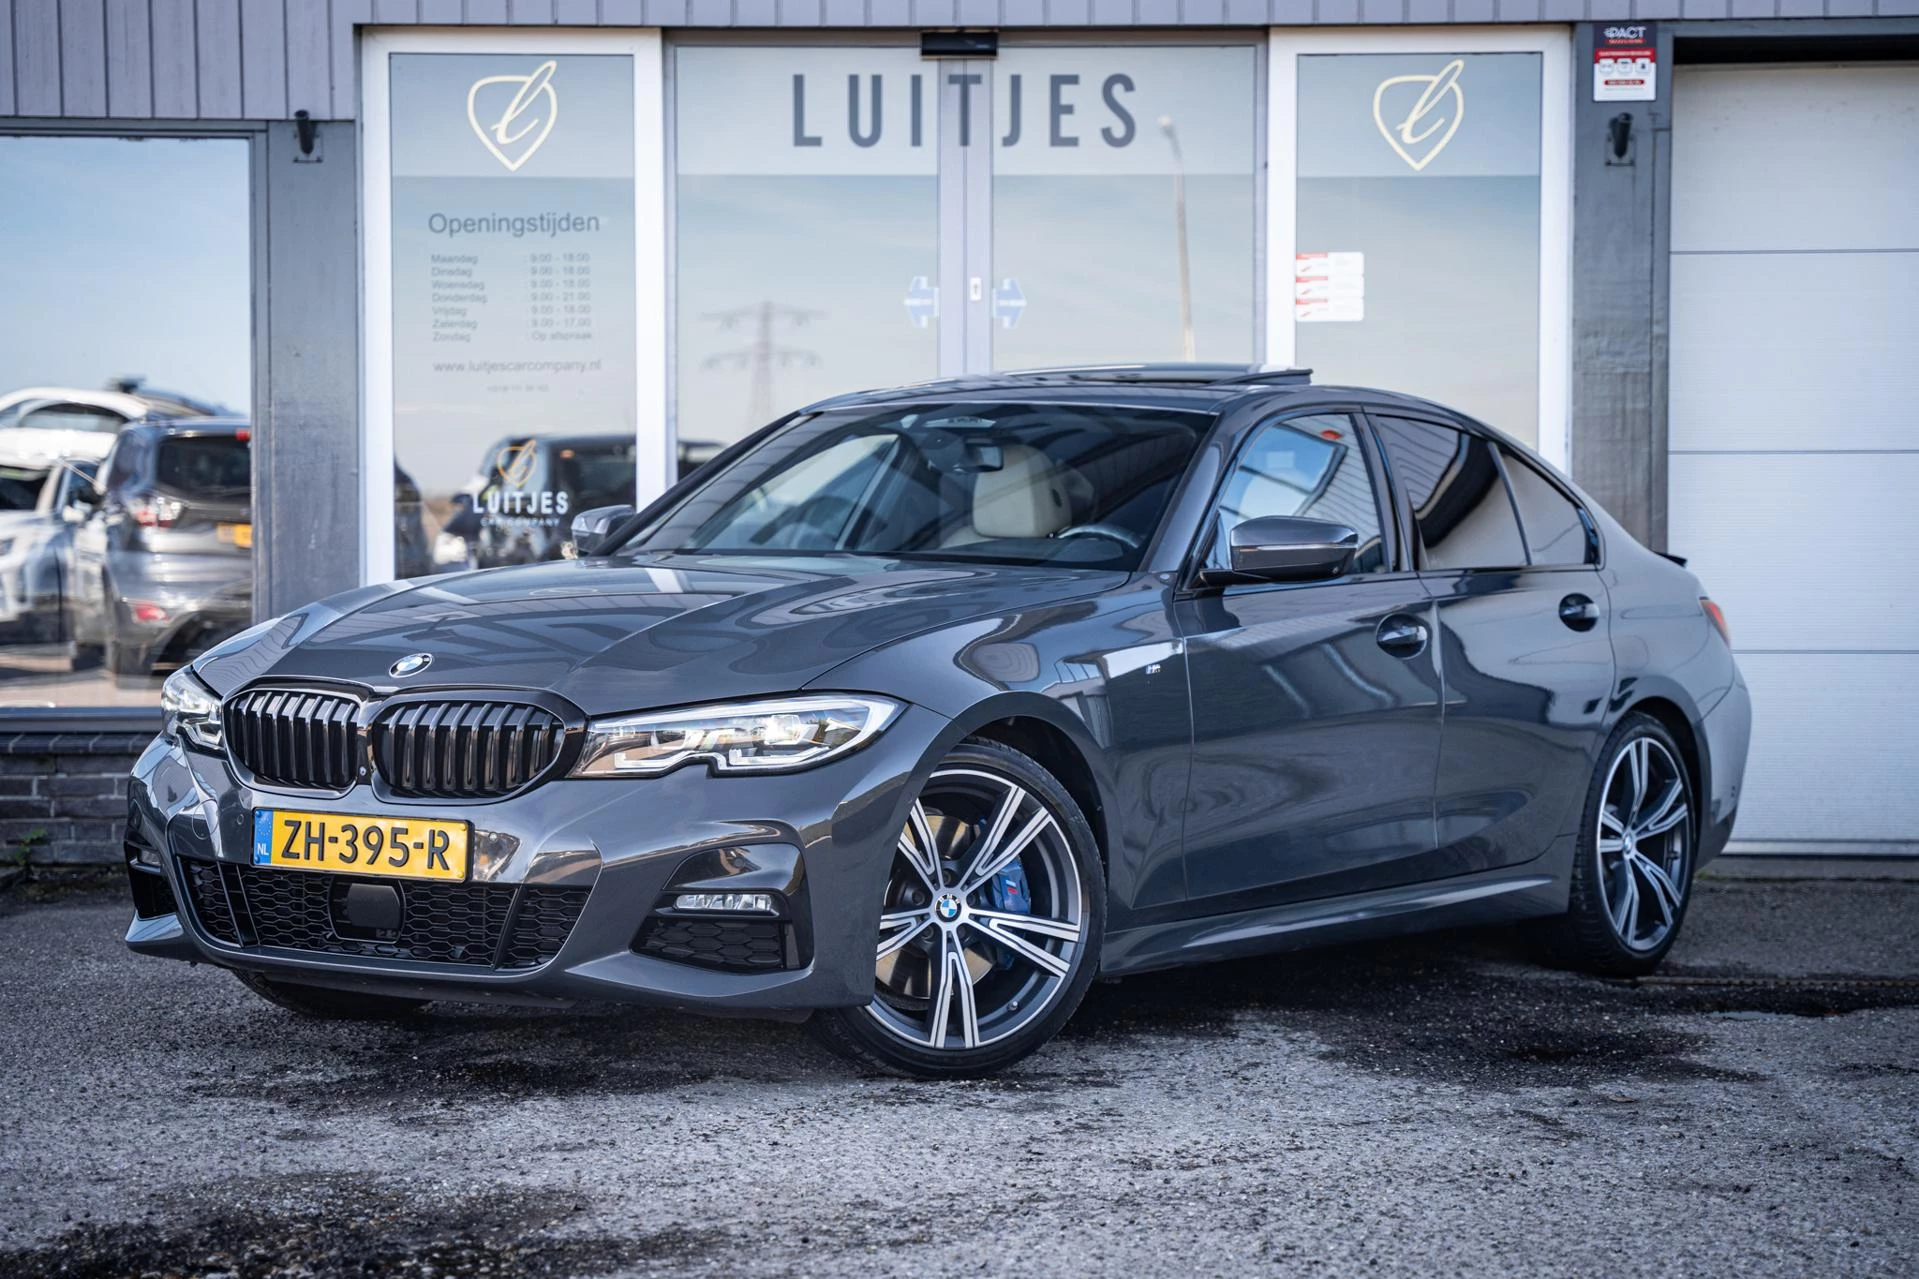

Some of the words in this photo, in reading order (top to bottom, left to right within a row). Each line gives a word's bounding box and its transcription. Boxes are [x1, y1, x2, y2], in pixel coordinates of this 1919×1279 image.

[792, 73, 1136, 148] LUITJES
[428, 212, 600, 237] Openingstijden
[472, 491, 569, 514] LUITJES
[257, 842, 269, 856] NL
[281, 819, 450, 871] ZH-395-R
